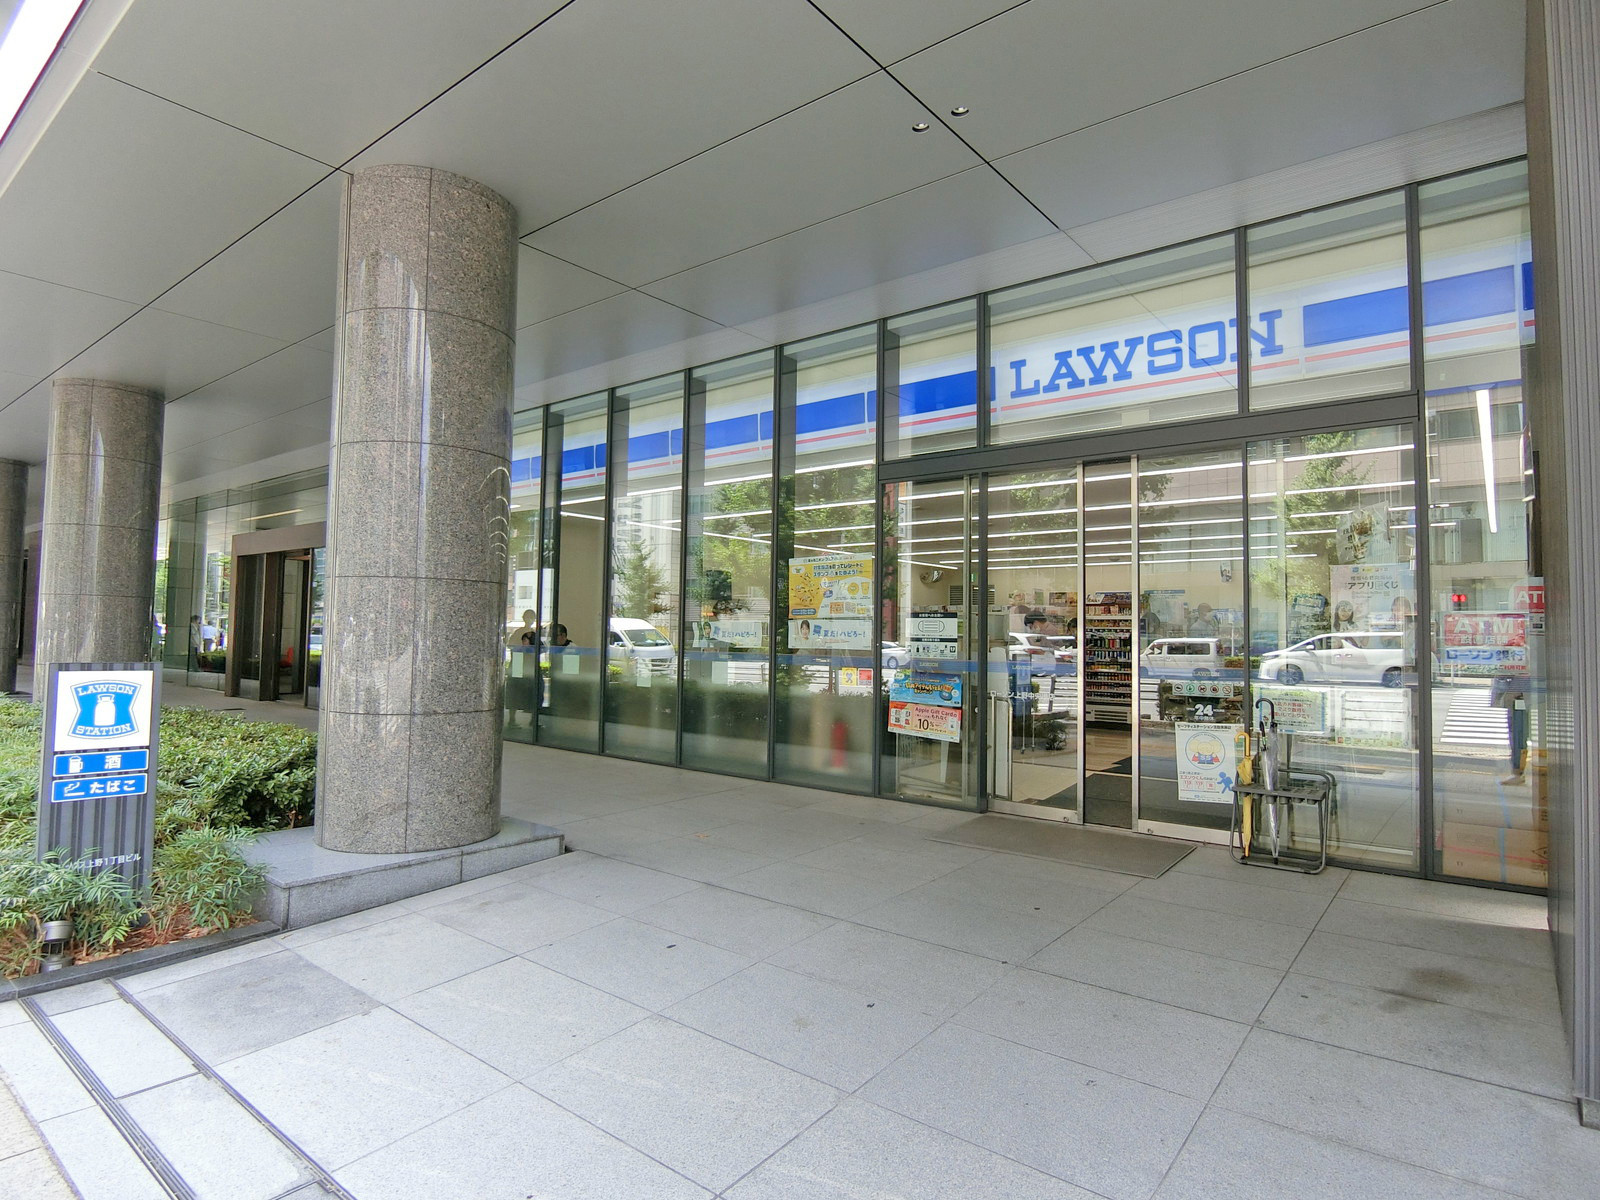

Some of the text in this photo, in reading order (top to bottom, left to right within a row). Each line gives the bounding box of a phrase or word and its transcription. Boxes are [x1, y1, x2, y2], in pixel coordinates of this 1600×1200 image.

[1009, 308, 1285, 399] LAWSON
[1516, 591, 1544, 603] AT
[1453, 616, 1514, 633] ATM
[1446, 650, 1525, 660] ローソン銀行
[77, 684, 135, 697] LAWSON
[915, 706, 930, 714] Apple
[1194, 704, 1213, 716] 24
[75, 722, 132, 736] STATION
[104, 754, 122, 769] 酒
[90, 780, 136, 794] たばこ
